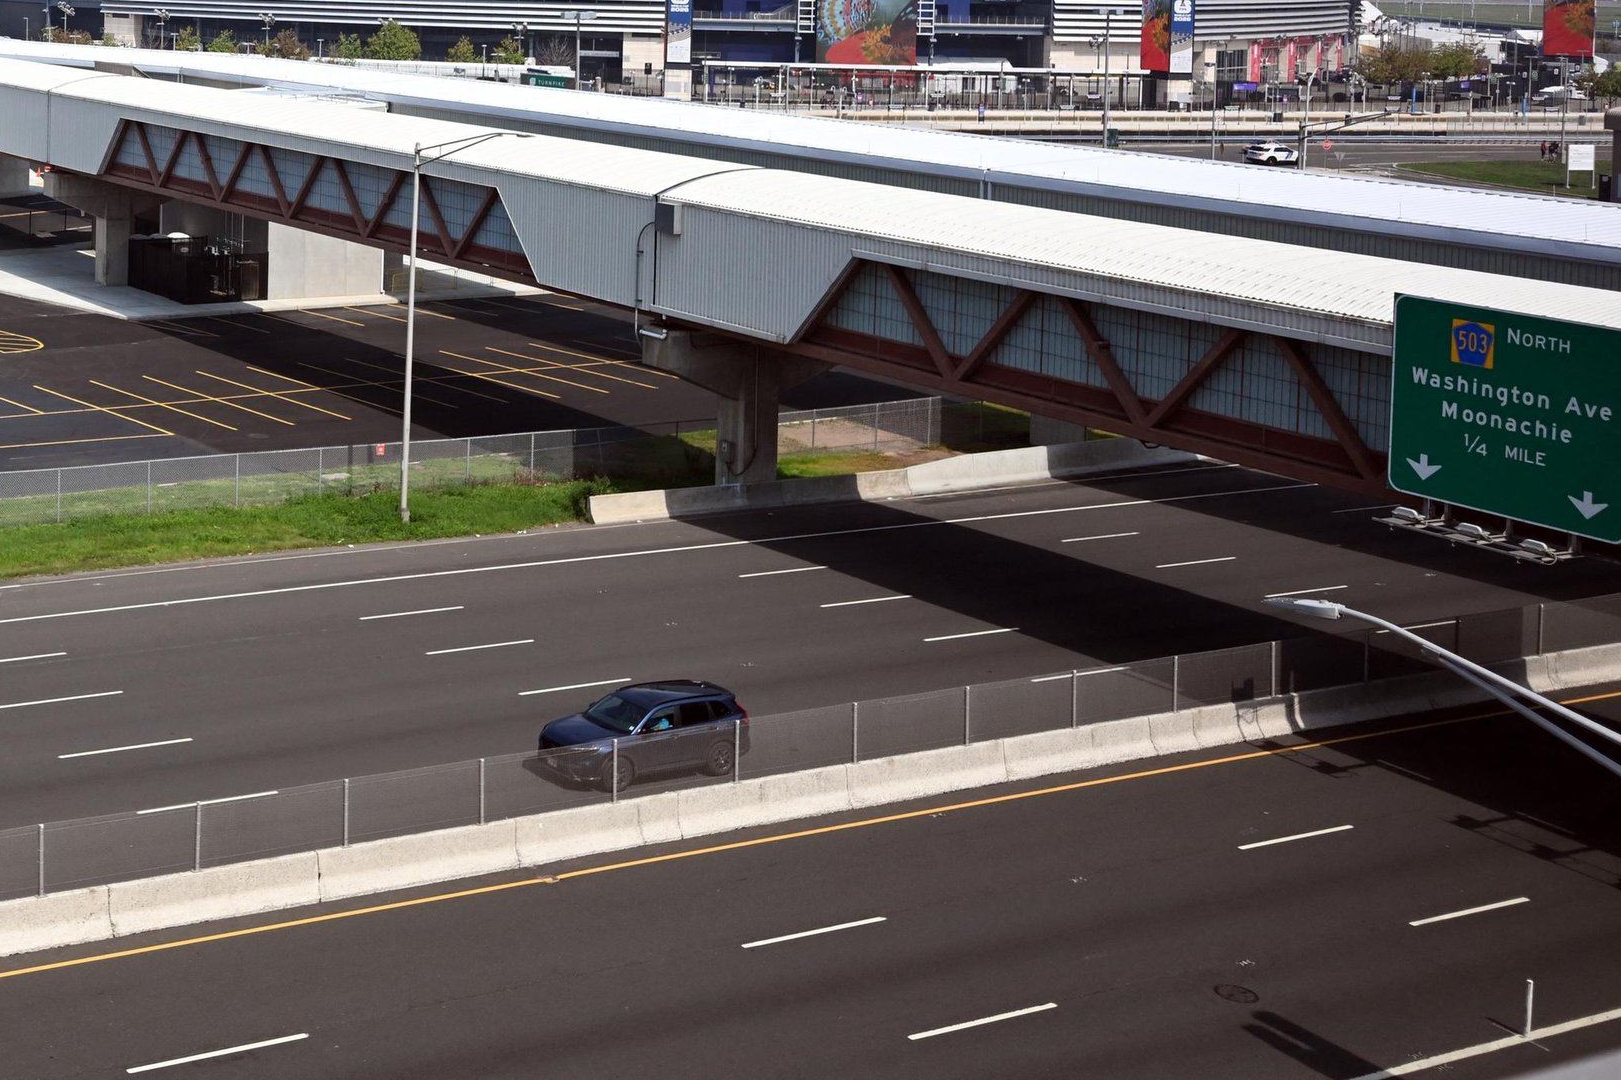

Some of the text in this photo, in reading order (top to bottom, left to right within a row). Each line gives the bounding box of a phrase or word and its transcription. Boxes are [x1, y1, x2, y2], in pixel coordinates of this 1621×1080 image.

[1458, 330, 1488, 354] 503
[1507, 327, 1571, 354] NORTH
[1412, 366, 1613, 421] Washington Ave
[1441, 400, 1573, 444] Moonachie
[1505, 445, 1547, 467] MILE
